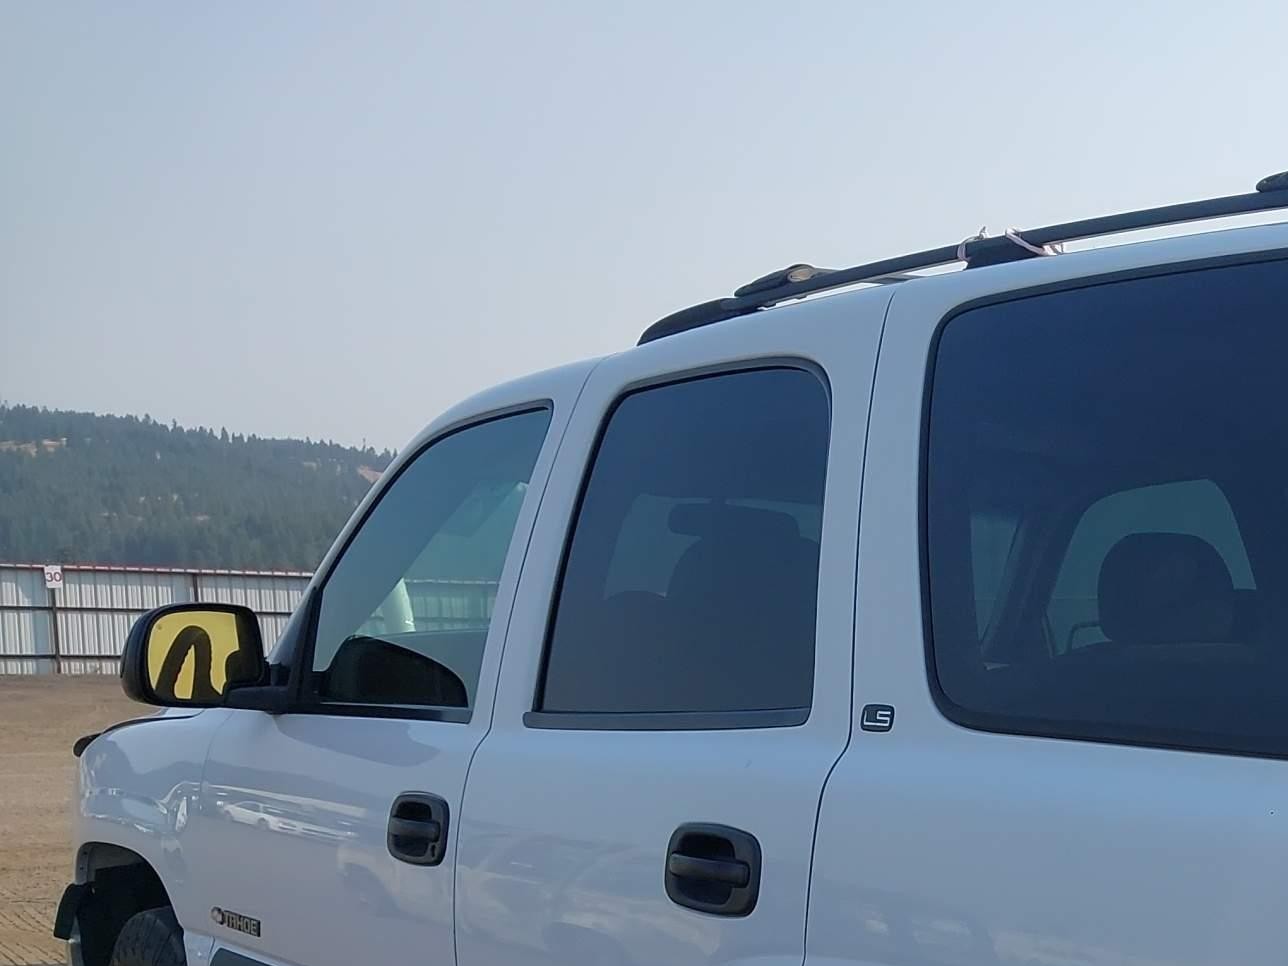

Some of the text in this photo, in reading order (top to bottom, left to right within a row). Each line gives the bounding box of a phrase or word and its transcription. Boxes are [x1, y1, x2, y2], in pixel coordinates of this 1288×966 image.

[46, 571, 63, 583] 30
[863, 710, 891, 727] LS
[222, 910, 261, 937] TAHOE
